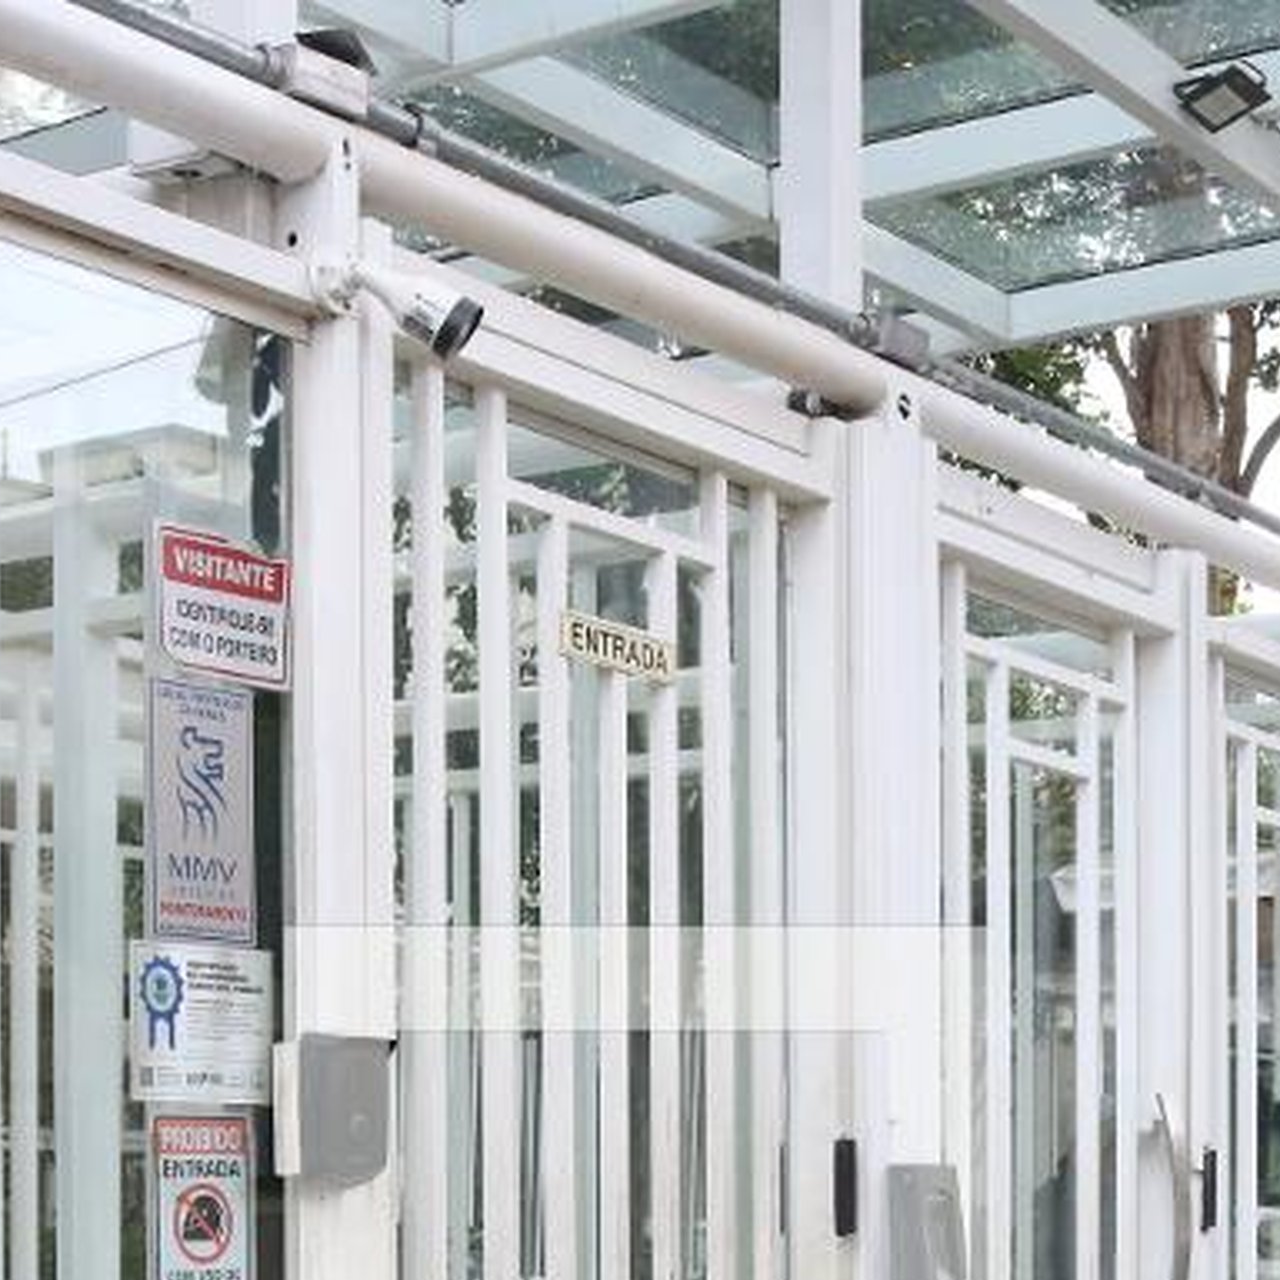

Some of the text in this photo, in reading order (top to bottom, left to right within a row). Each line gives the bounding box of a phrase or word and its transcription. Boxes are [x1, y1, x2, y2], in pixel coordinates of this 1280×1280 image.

[174, 547, 276, 591] VISITANTE
[571, 621, 668, 675] ENTRADA
[168, 852, 237, 881] MMV
[160, 1127, 241, 1151] PROIBIDO
[163, 1159, 241, 1178] ENTRADA
